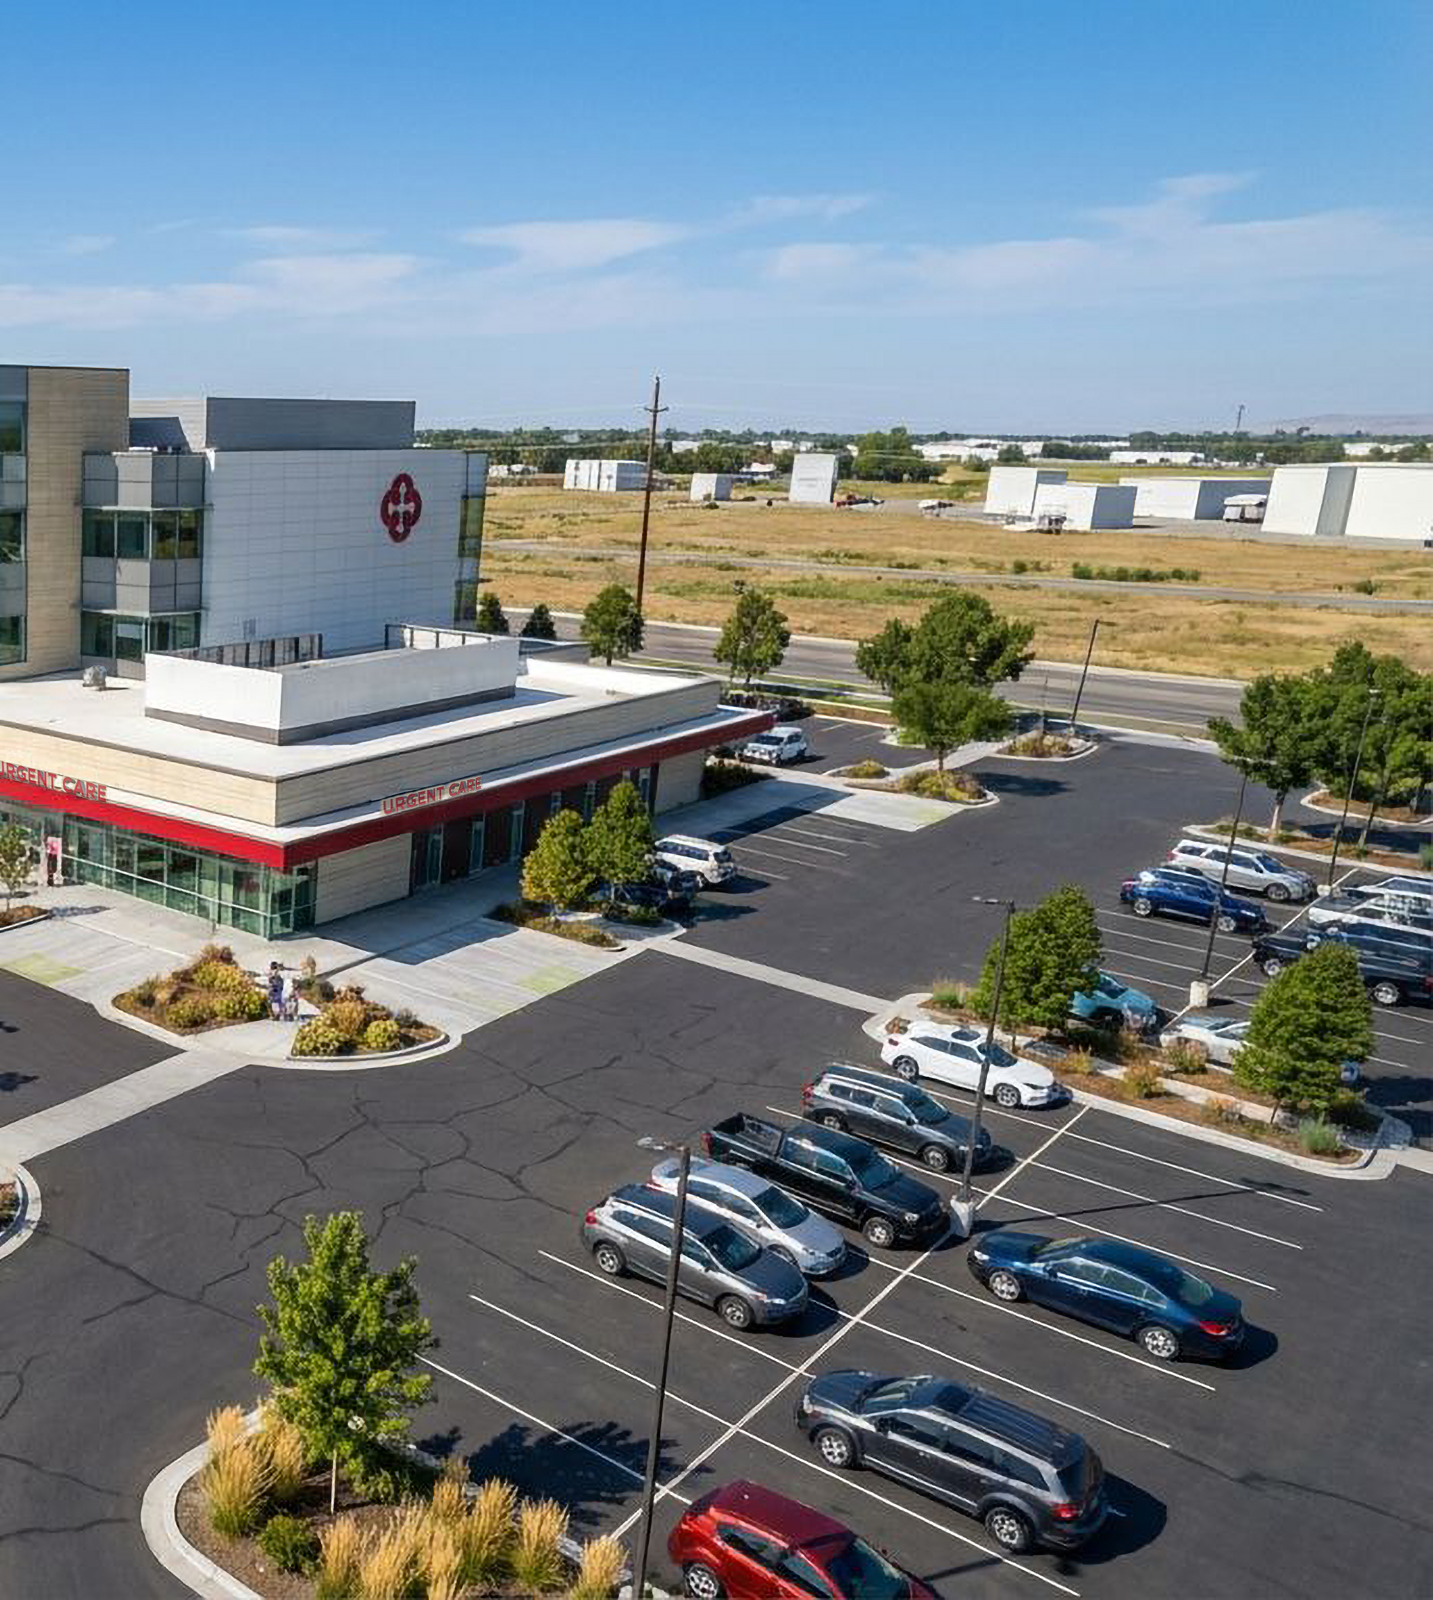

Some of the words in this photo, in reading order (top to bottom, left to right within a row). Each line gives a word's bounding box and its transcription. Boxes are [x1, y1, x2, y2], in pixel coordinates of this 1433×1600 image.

[62, 776, 107, 803] CARE
[382, 786, 445, 815] URGENT
[448, 776, 482, 797] CARE
